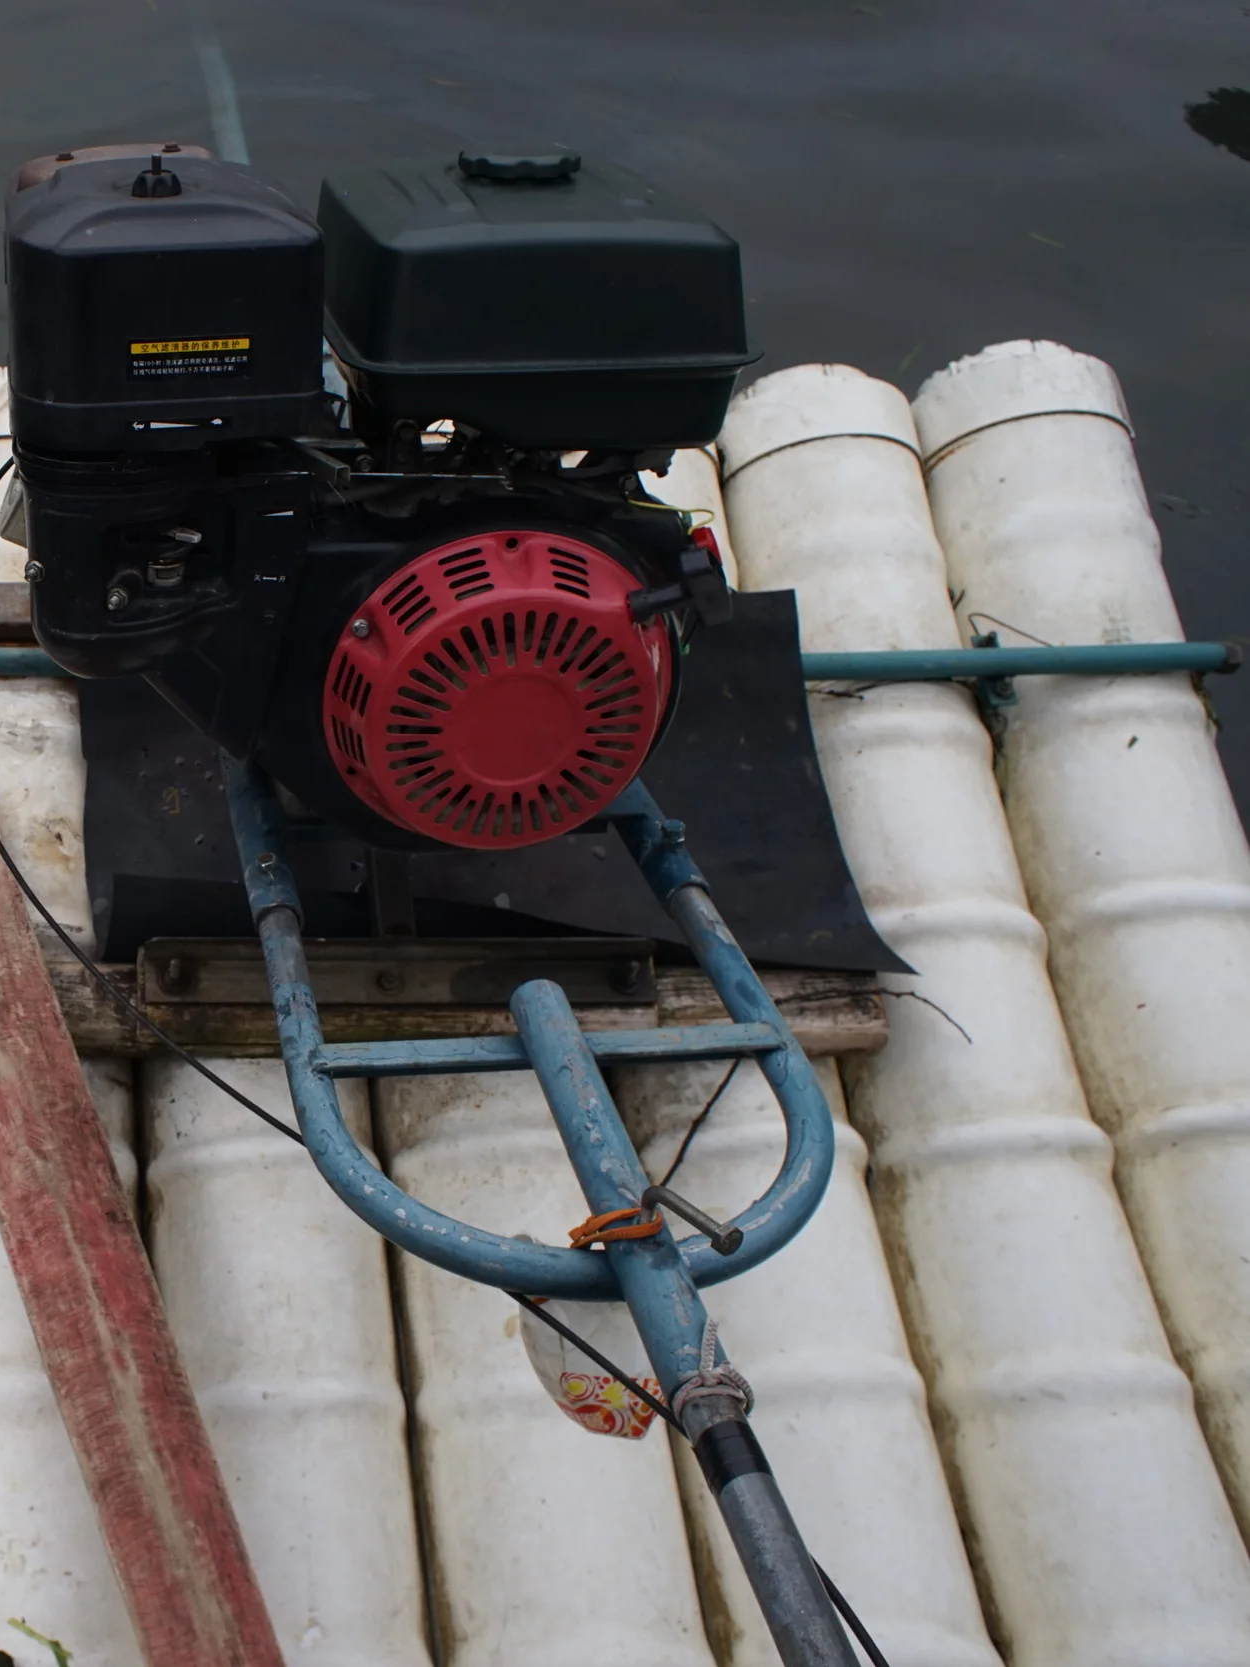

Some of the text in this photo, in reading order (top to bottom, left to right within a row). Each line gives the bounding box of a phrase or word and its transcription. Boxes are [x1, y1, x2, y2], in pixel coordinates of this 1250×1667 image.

[141, 341, 240, 353] 空气滤清器的保养维护
